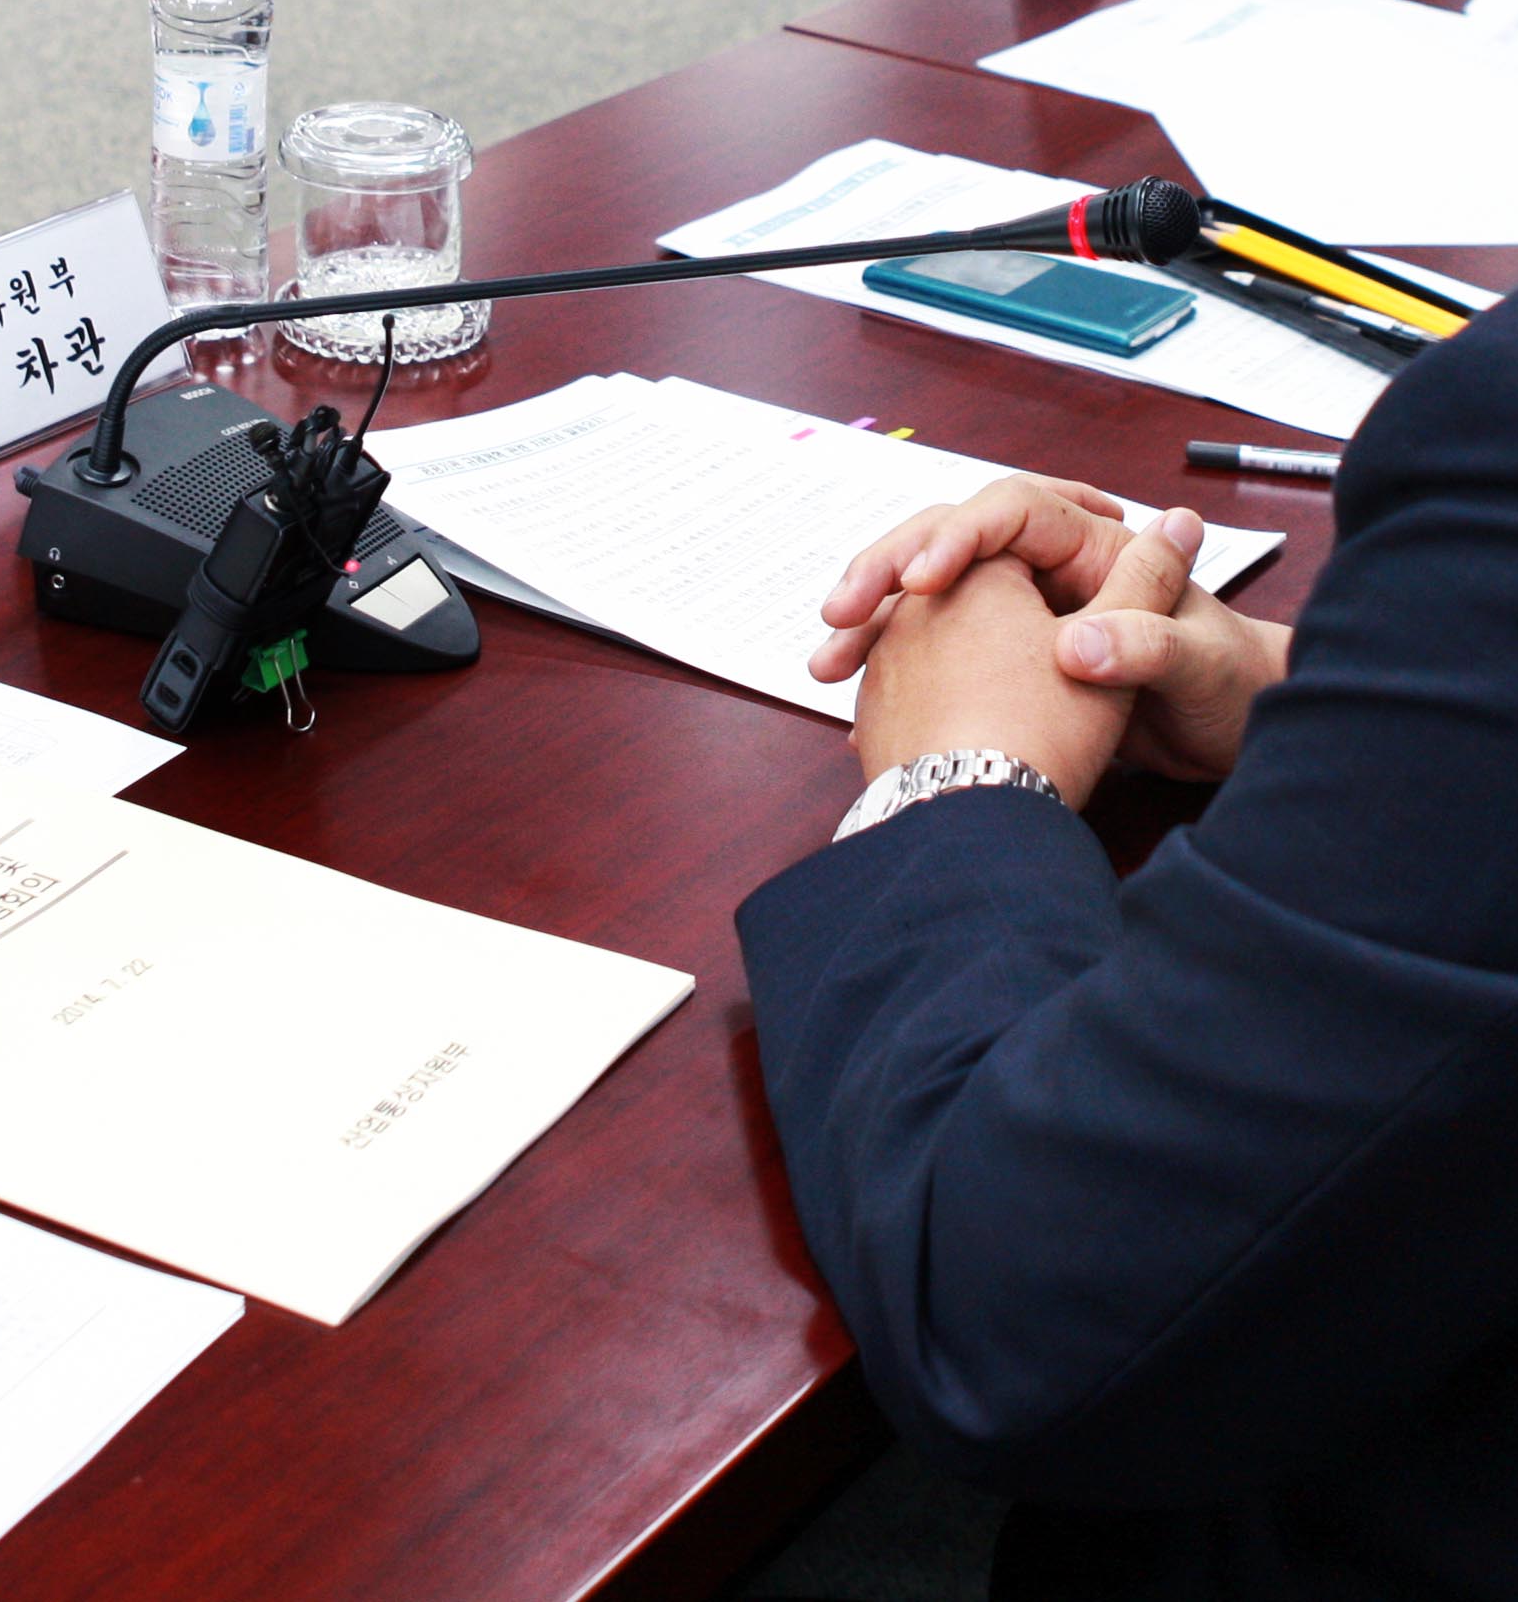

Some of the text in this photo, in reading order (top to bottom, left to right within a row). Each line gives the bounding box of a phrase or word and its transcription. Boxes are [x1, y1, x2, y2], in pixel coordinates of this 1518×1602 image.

[16, 317, 106, 394] 차관
[179, 386, 216, 400] BOSCH
[121, 957, 154, 978] 22
[339, 1041, 472, 1150] 산업통상자원부
